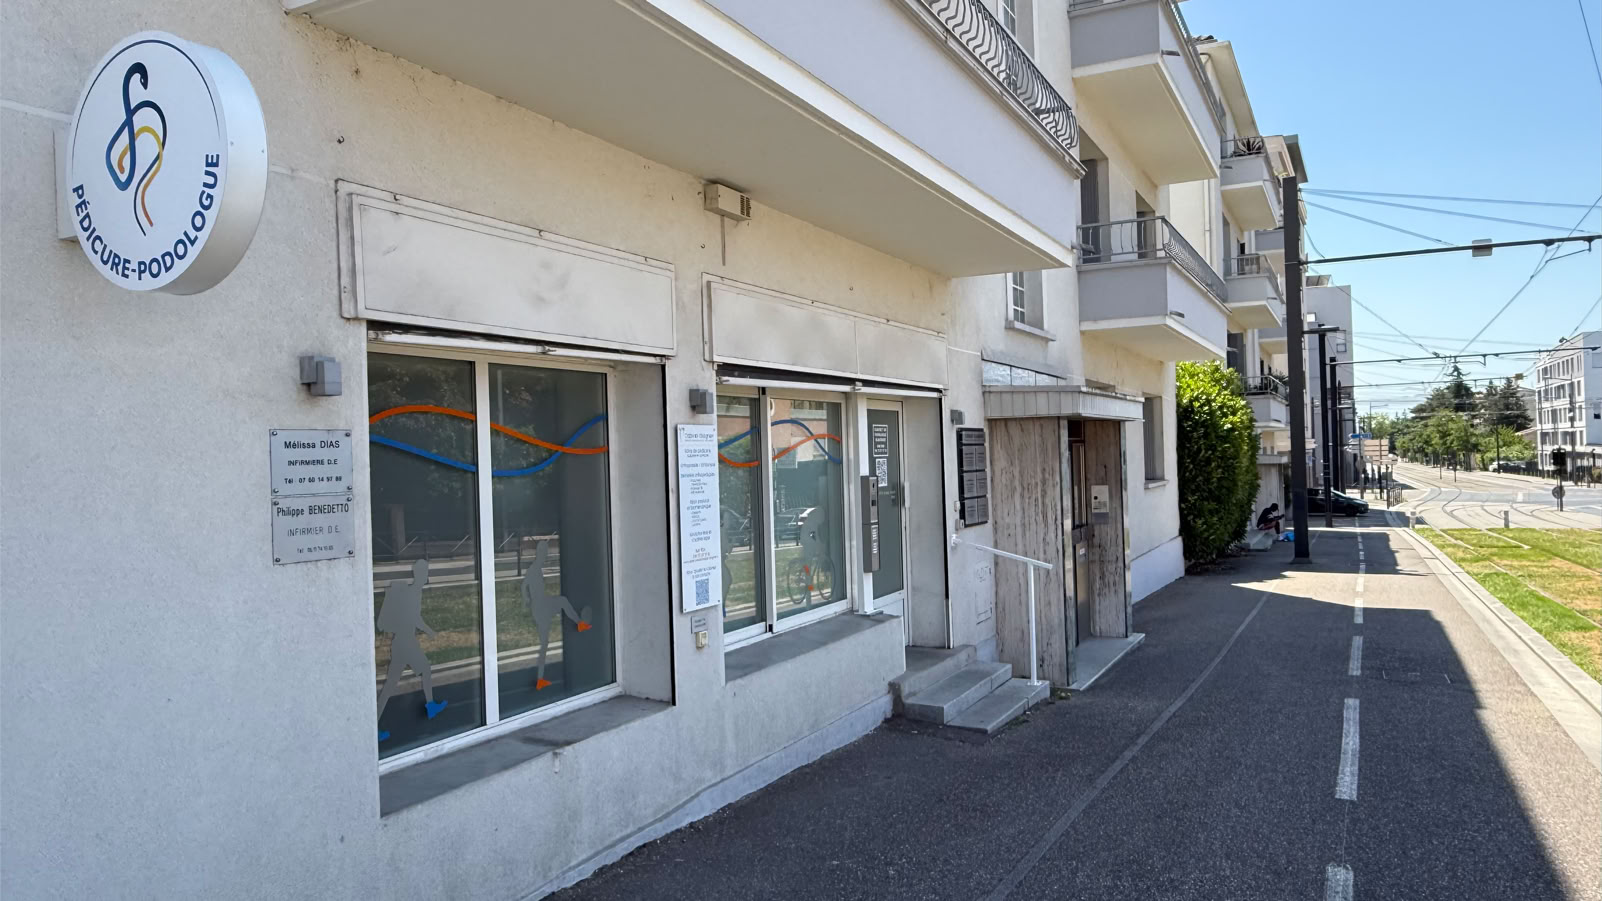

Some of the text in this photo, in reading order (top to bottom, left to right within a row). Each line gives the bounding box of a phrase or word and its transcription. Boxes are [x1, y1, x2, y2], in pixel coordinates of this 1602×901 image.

[72, 153, 220, 280] PÉDICURE-PODOLOGUE
[284, 440, 340, 449] Mélissa DIAS
[276, 503, 349, 518] Philippe BENEDETTO
[287, 526, 324, 537] INFIRMIER
